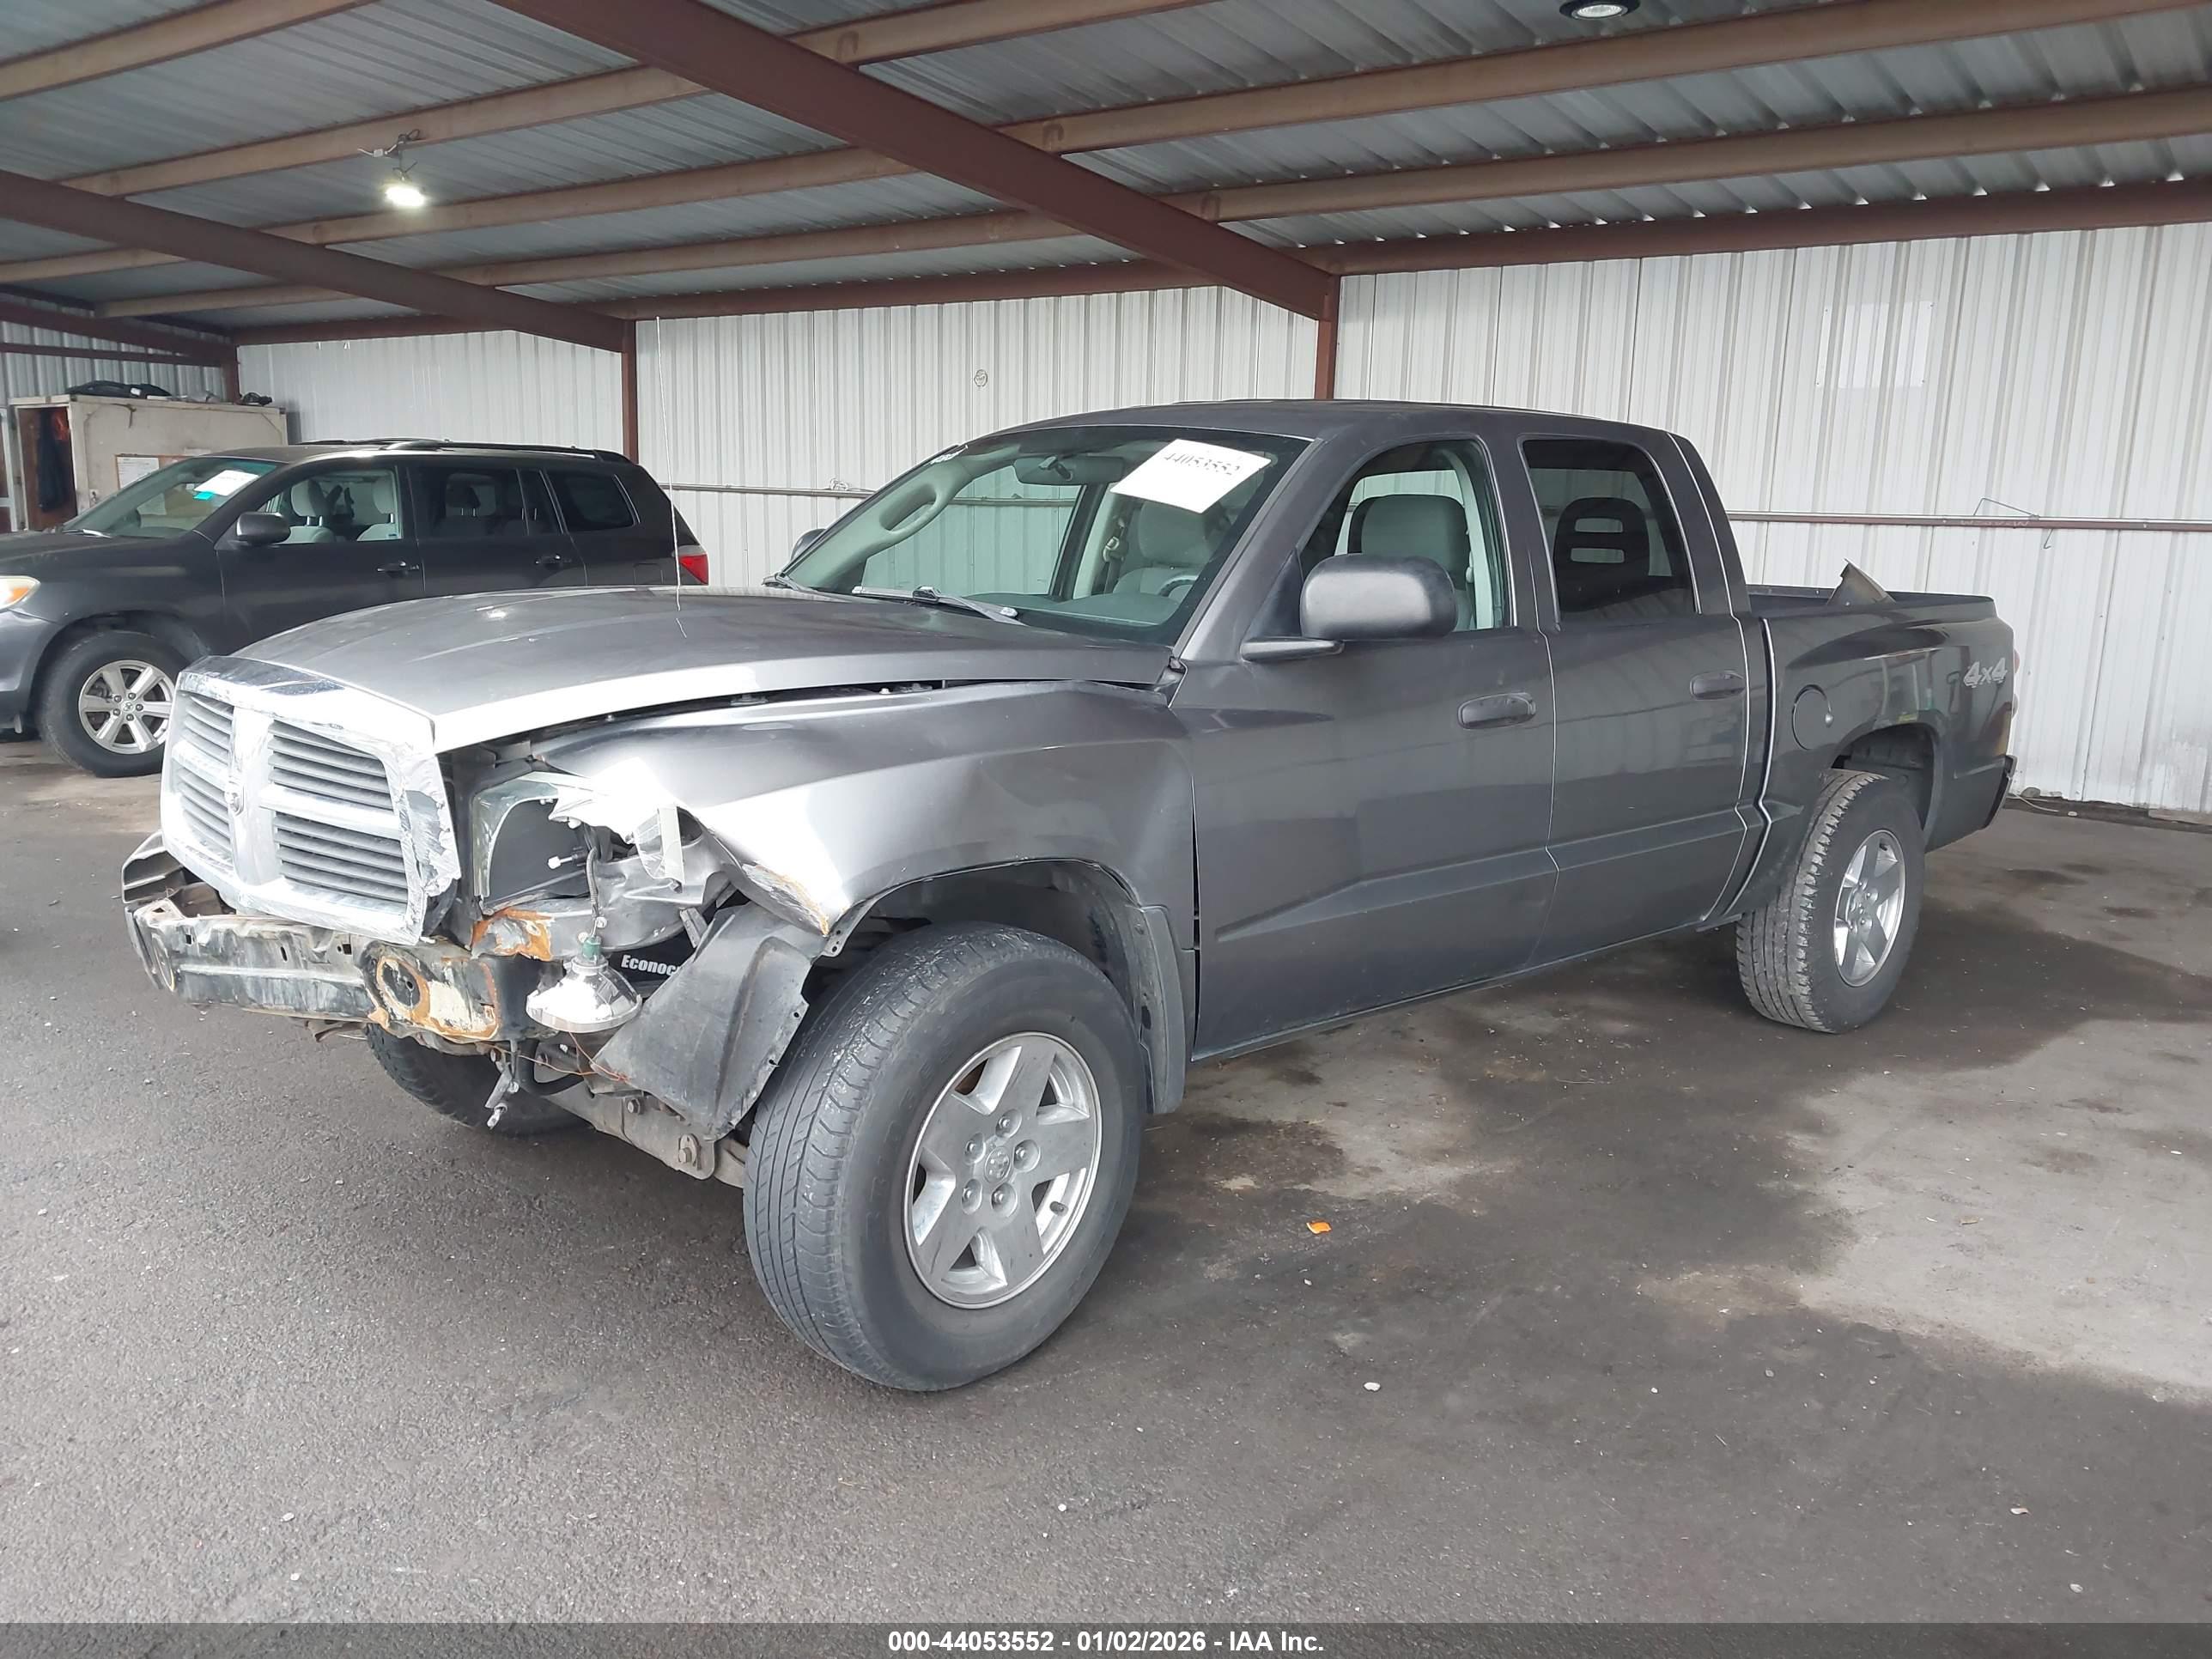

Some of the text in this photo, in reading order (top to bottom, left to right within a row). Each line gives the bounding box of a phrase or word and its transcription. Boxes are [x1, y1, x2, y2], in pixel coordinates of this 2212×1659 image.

[1164, 453, 1241, 477] 44053552
[1963, 657, 2008, 689] 4x4
[621, 954, 682, 976] Econoc
